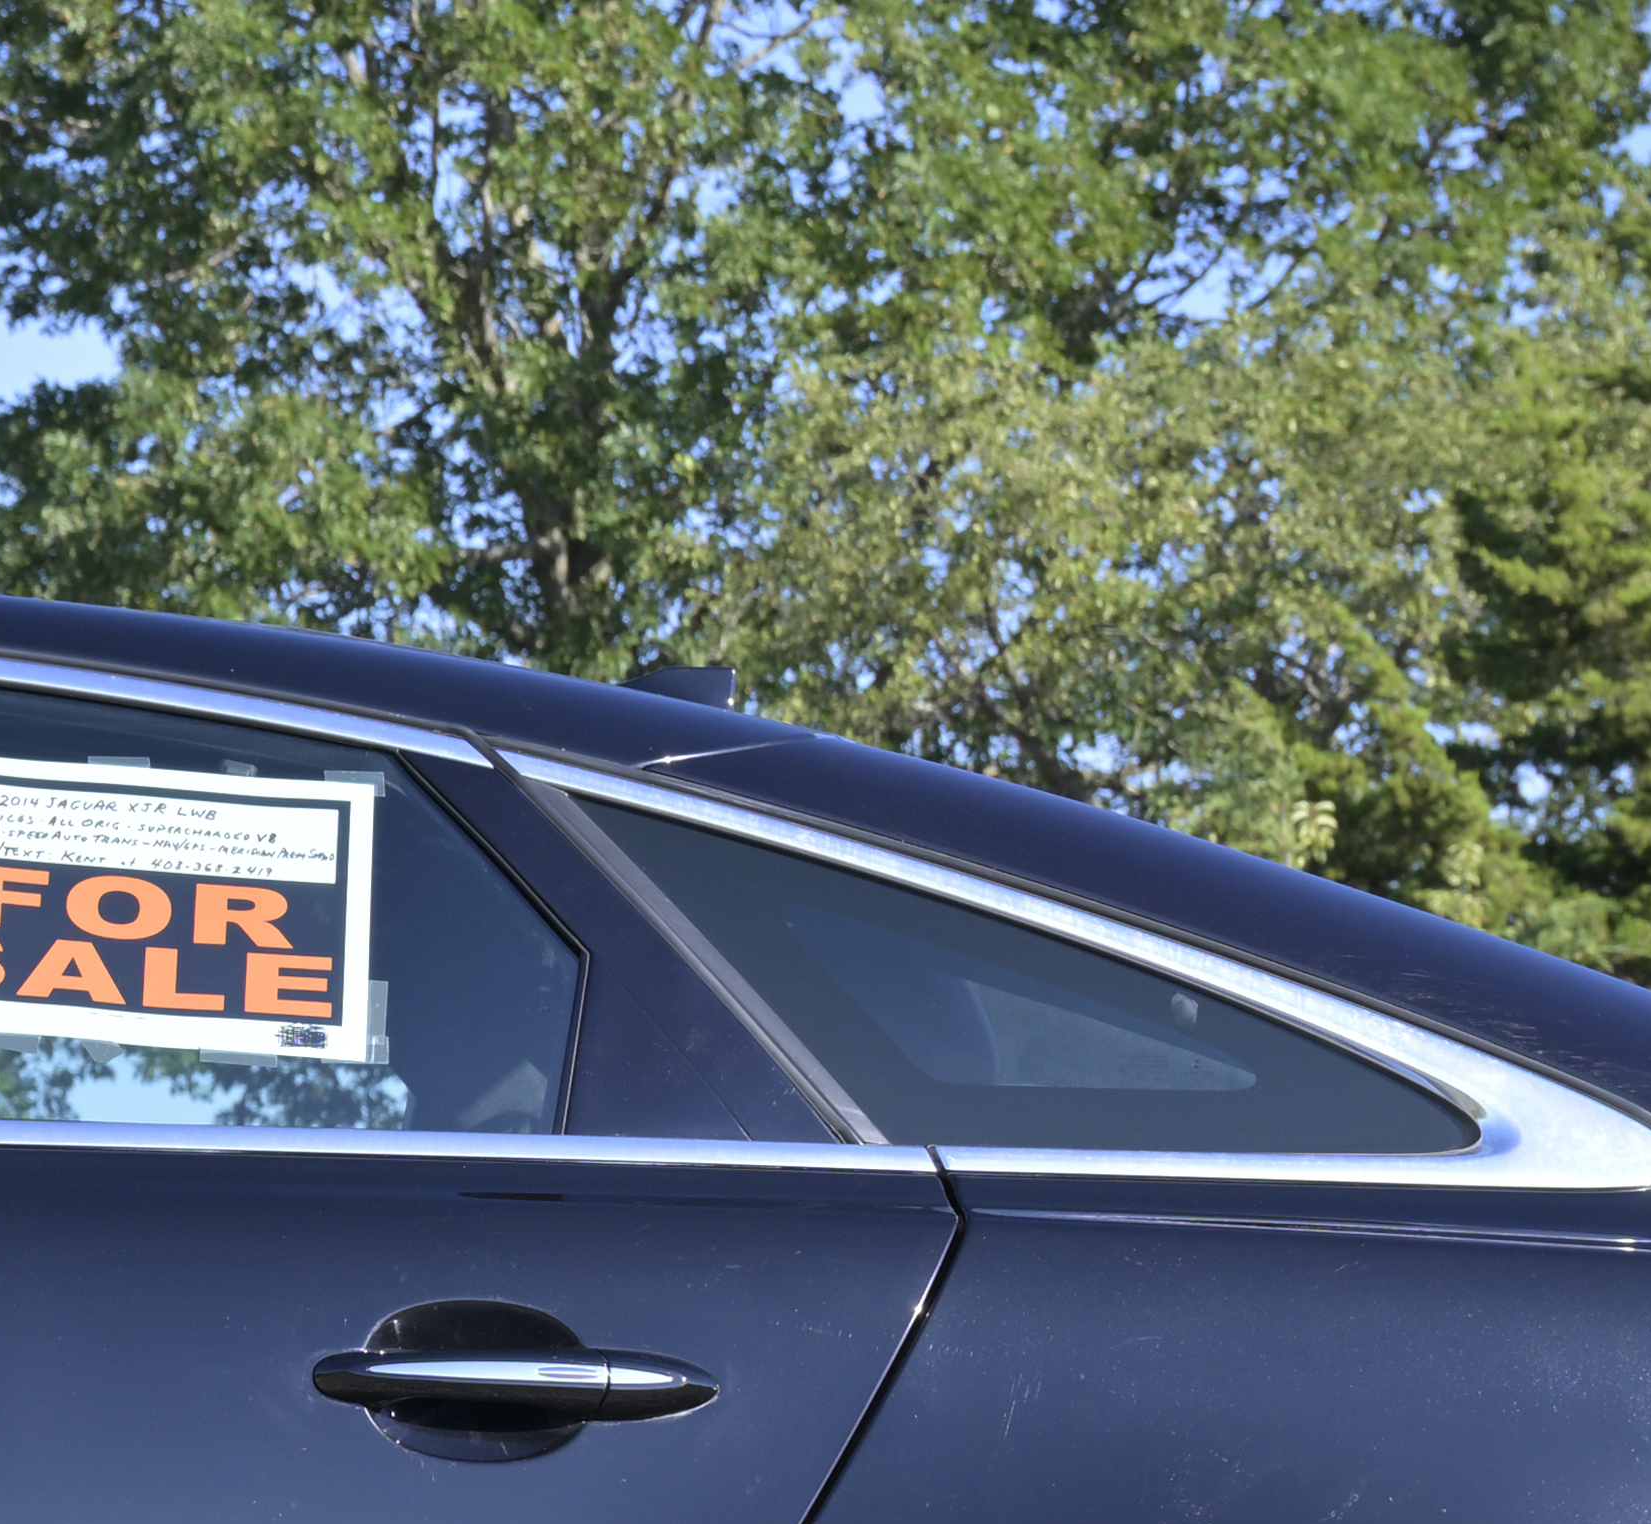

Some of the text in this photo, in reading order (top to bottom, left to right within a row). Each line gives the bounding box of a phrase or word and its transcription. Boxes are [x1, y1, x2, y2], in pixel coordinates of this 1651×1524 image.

[46, 797, 118, 812] JAGUAR
[128, 802, 167, 815] XJR
[177, 807, 217, 821] LWB
[48, 815, 74, 827] ALL
[81, 818, 120, 831] ORIG
[257, 833, 277, 843] V8
[51, 831, 88, 843] AUTO
[93, 834, 138, 846] TRANS
